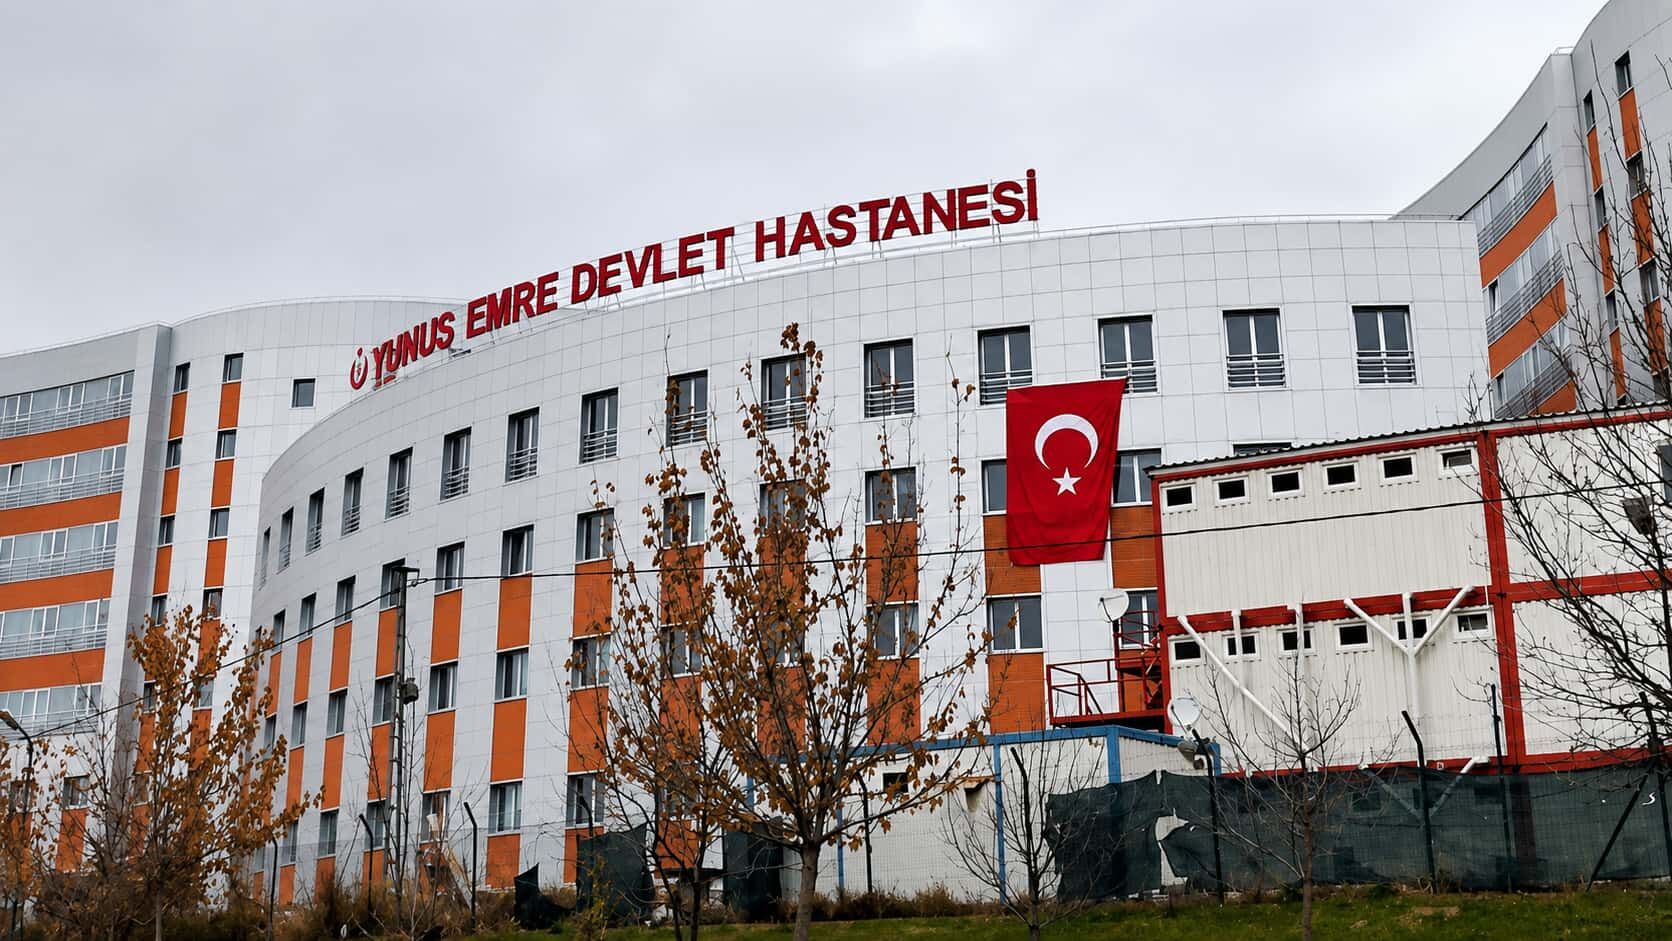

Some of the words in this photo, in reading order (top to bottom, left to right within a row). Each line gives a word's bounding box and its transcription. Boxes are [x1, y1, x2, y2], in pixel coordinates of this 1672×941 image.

[373, 311, 456, 387] YUNUS
[466, 272, 559, 338] EMRE
[571, 226, 735, 304] DEVLET
[755, 168, 1039, 262] HASTANESİ
